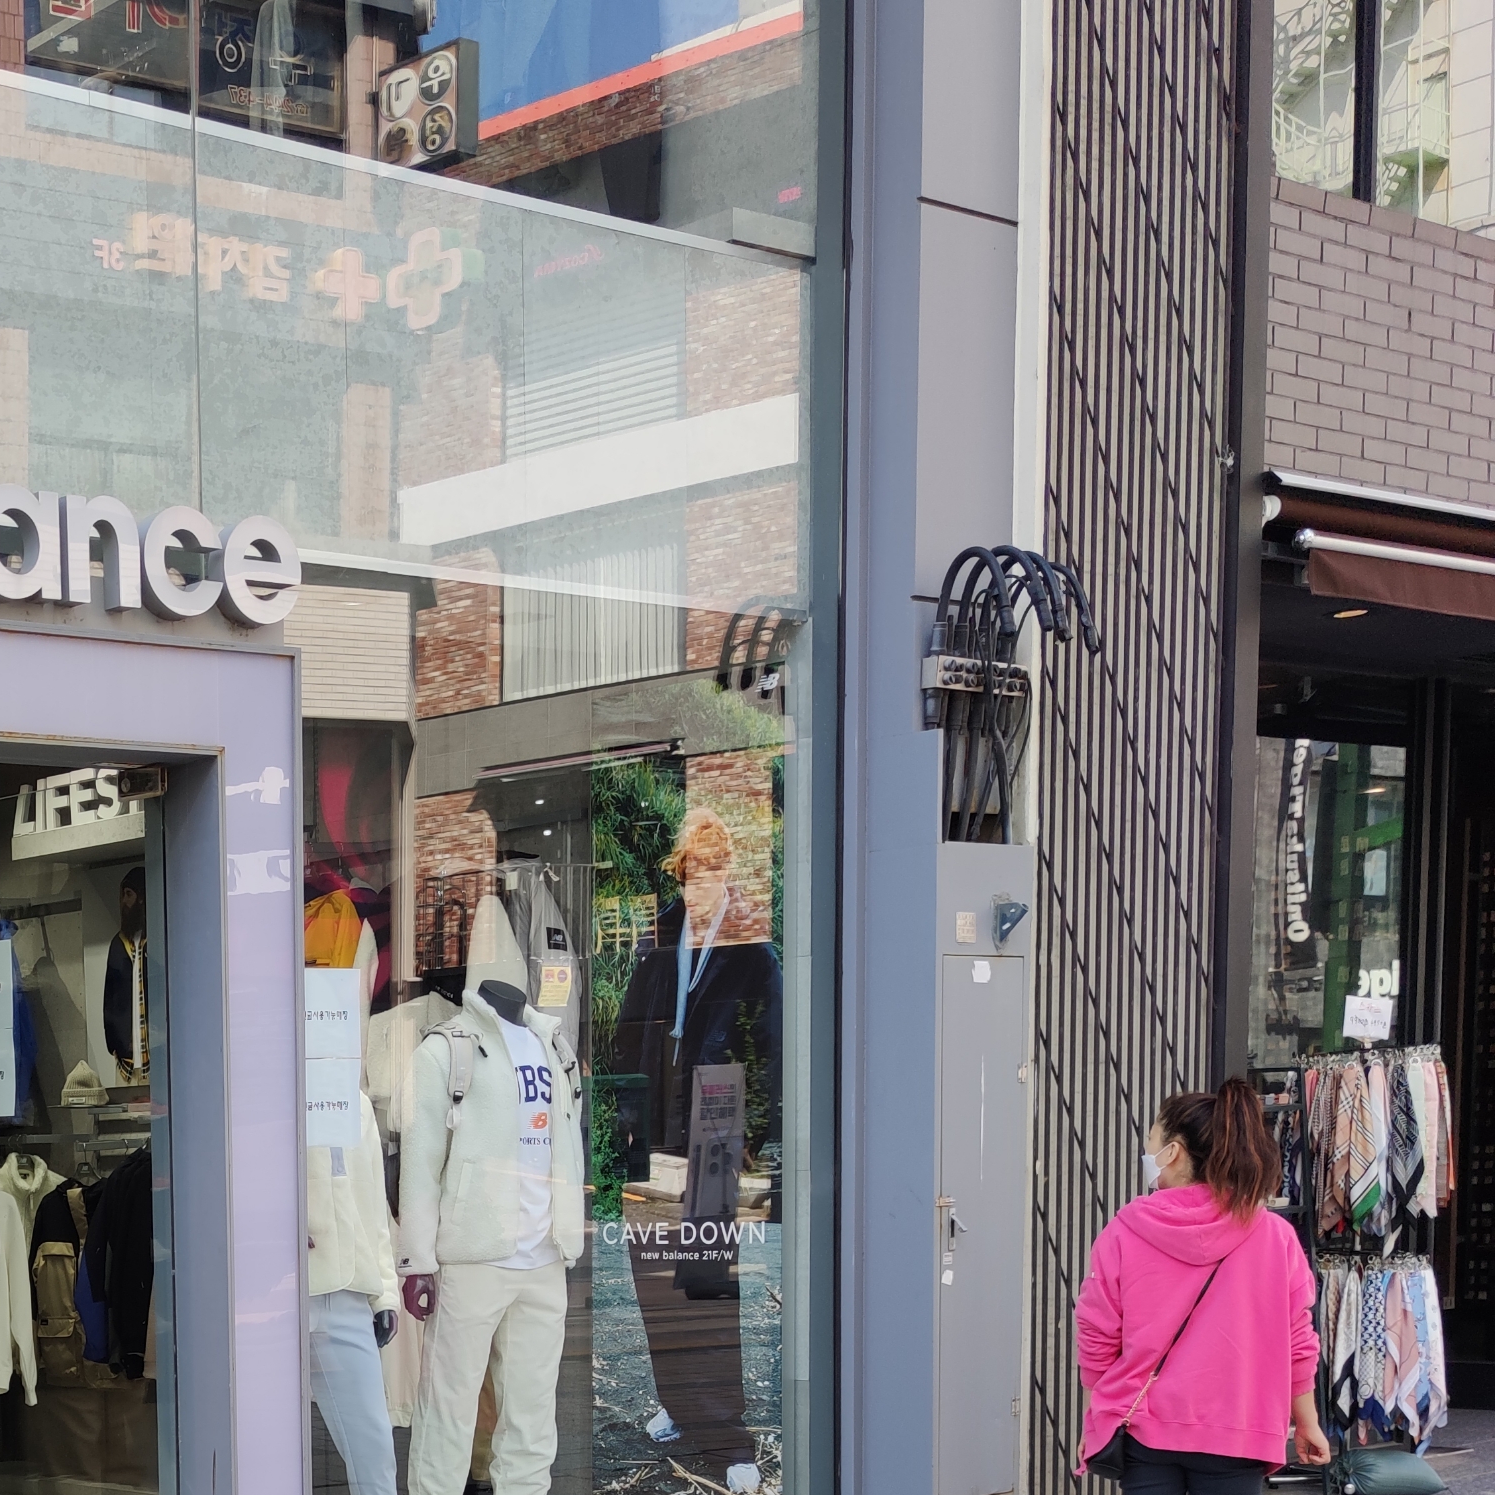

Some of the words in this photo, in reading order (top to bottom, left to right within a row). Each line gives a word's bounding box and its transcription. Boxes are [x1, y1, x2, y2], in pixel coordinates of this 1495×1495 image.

[13, 768, 140, 837] LIFES
[515, 1065, 552, 1104] BS
[602, 1221, 669, 1245] CAVE
[680, 1221, 766, 1245] DOWN
[641, 1252, 660, 1260] new
[663, 1250, 699, 1260] balance
[702, 1250, 733, 1261] 21F/W
